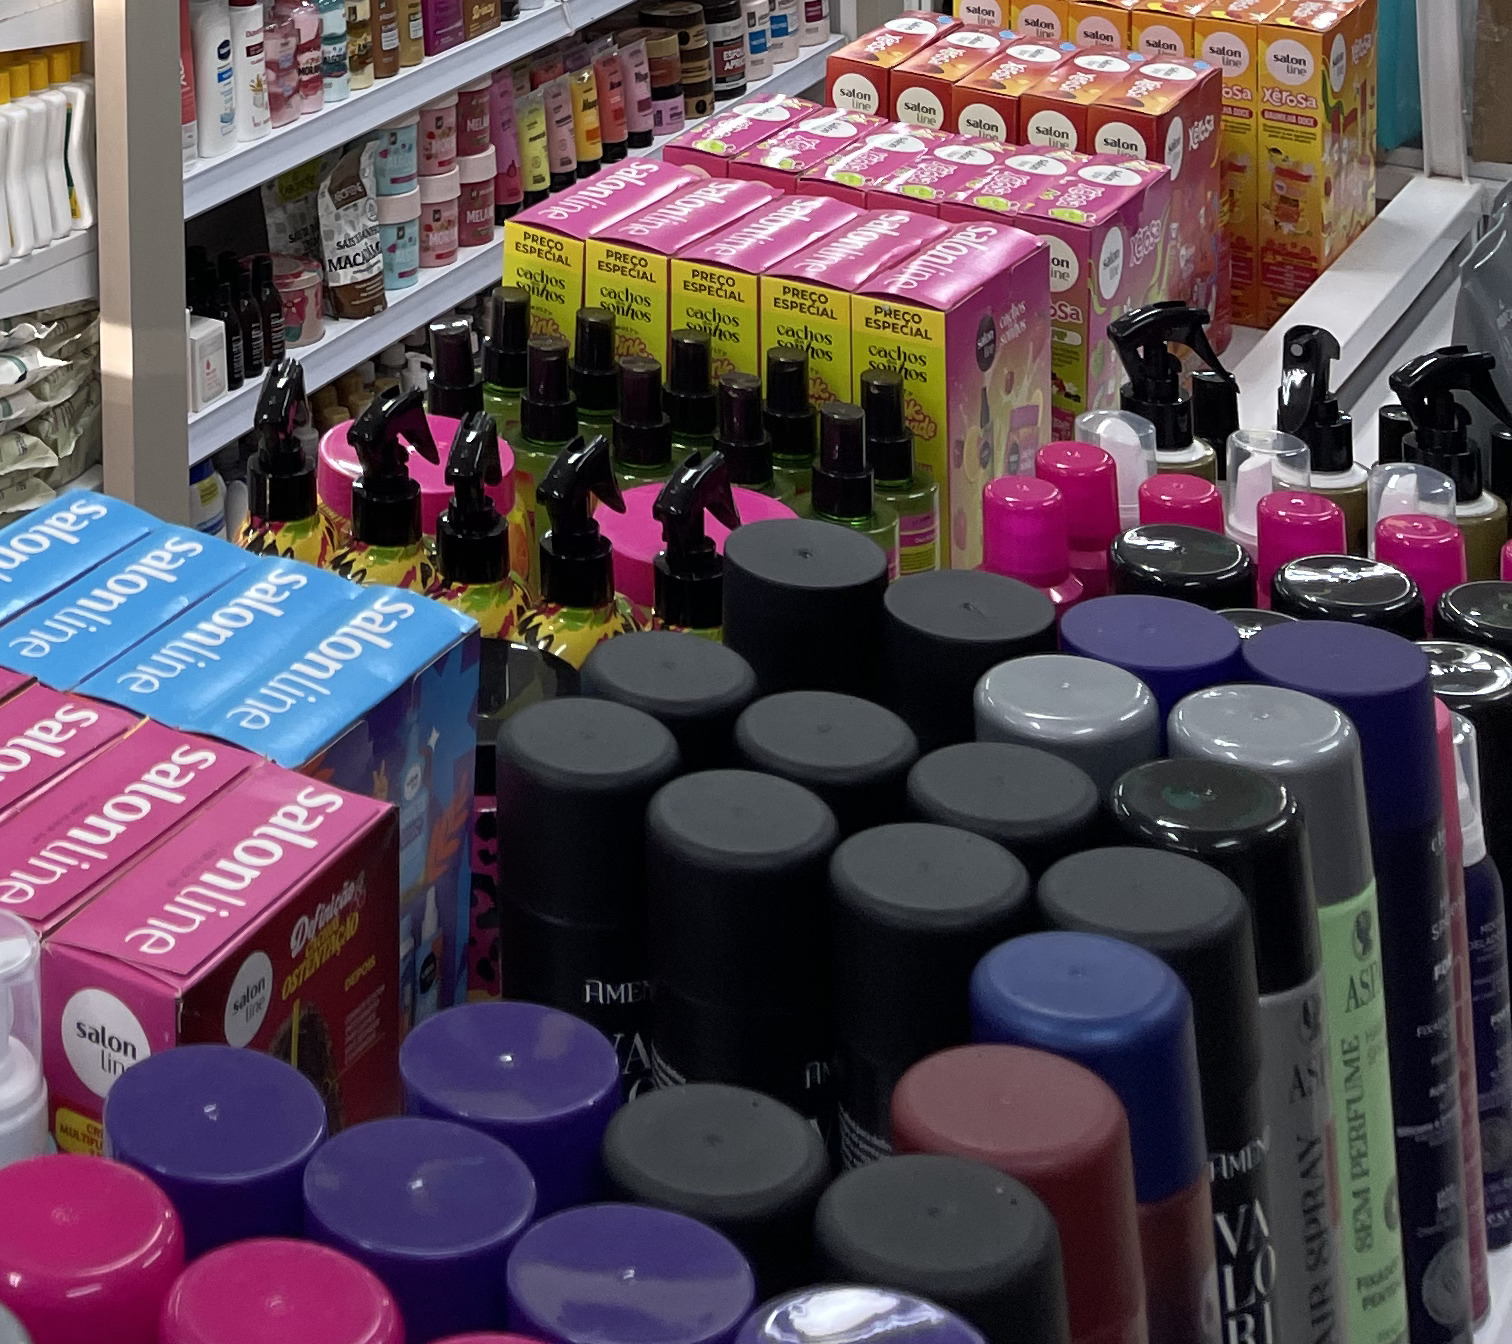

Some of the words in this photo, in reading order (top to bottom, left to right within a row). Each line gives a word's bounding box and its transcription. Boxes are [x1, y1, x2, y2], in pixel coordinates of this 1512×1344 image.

[965, 2, 996, 19] salon
[839, 85, 872, 104] salon
[903, 99, 937, 117] salon
[966, 116, 1000, 134] salon
[1035, 123, 1070, 142] salon
[1103, 134, 1140, 153] salon
[538, 161, 660, 220] salonline
[618, 181, 740, 236] salonline
[514, 241, 572, 267] ESPECIAL
[523, 231, 564, 253] PREÇO
[597, 260, 657, 284] ESPECIAL
[605, 249, 649, 270] PREÇO
[516, 266, 566, 290] cachos
[691, 268, 736, 289] PREÇO
[599, 286, 652, 308] cachos
[683, 279, 745, 304] ESPECIAL
[686, 306, 740, 328] cachos
[8, 535, 205, 658] salonline
[116, 567, 308, 695] salonline
[226, 594, 415, 730] salonline
[124, 785, 344, 955] salonline
[344, 955, 377, 992] DEPOIS
[244, 996, 266, 1024] line
[75, 1020, 138, 1062] salon
[100, 1050, 129, 1076] lin
[1340, 1032, 1371, 1180] PERFUME
[1296, 1133, 1330, 1276] SPRAY
[1352, 1186, 1375, 1255] SEM
